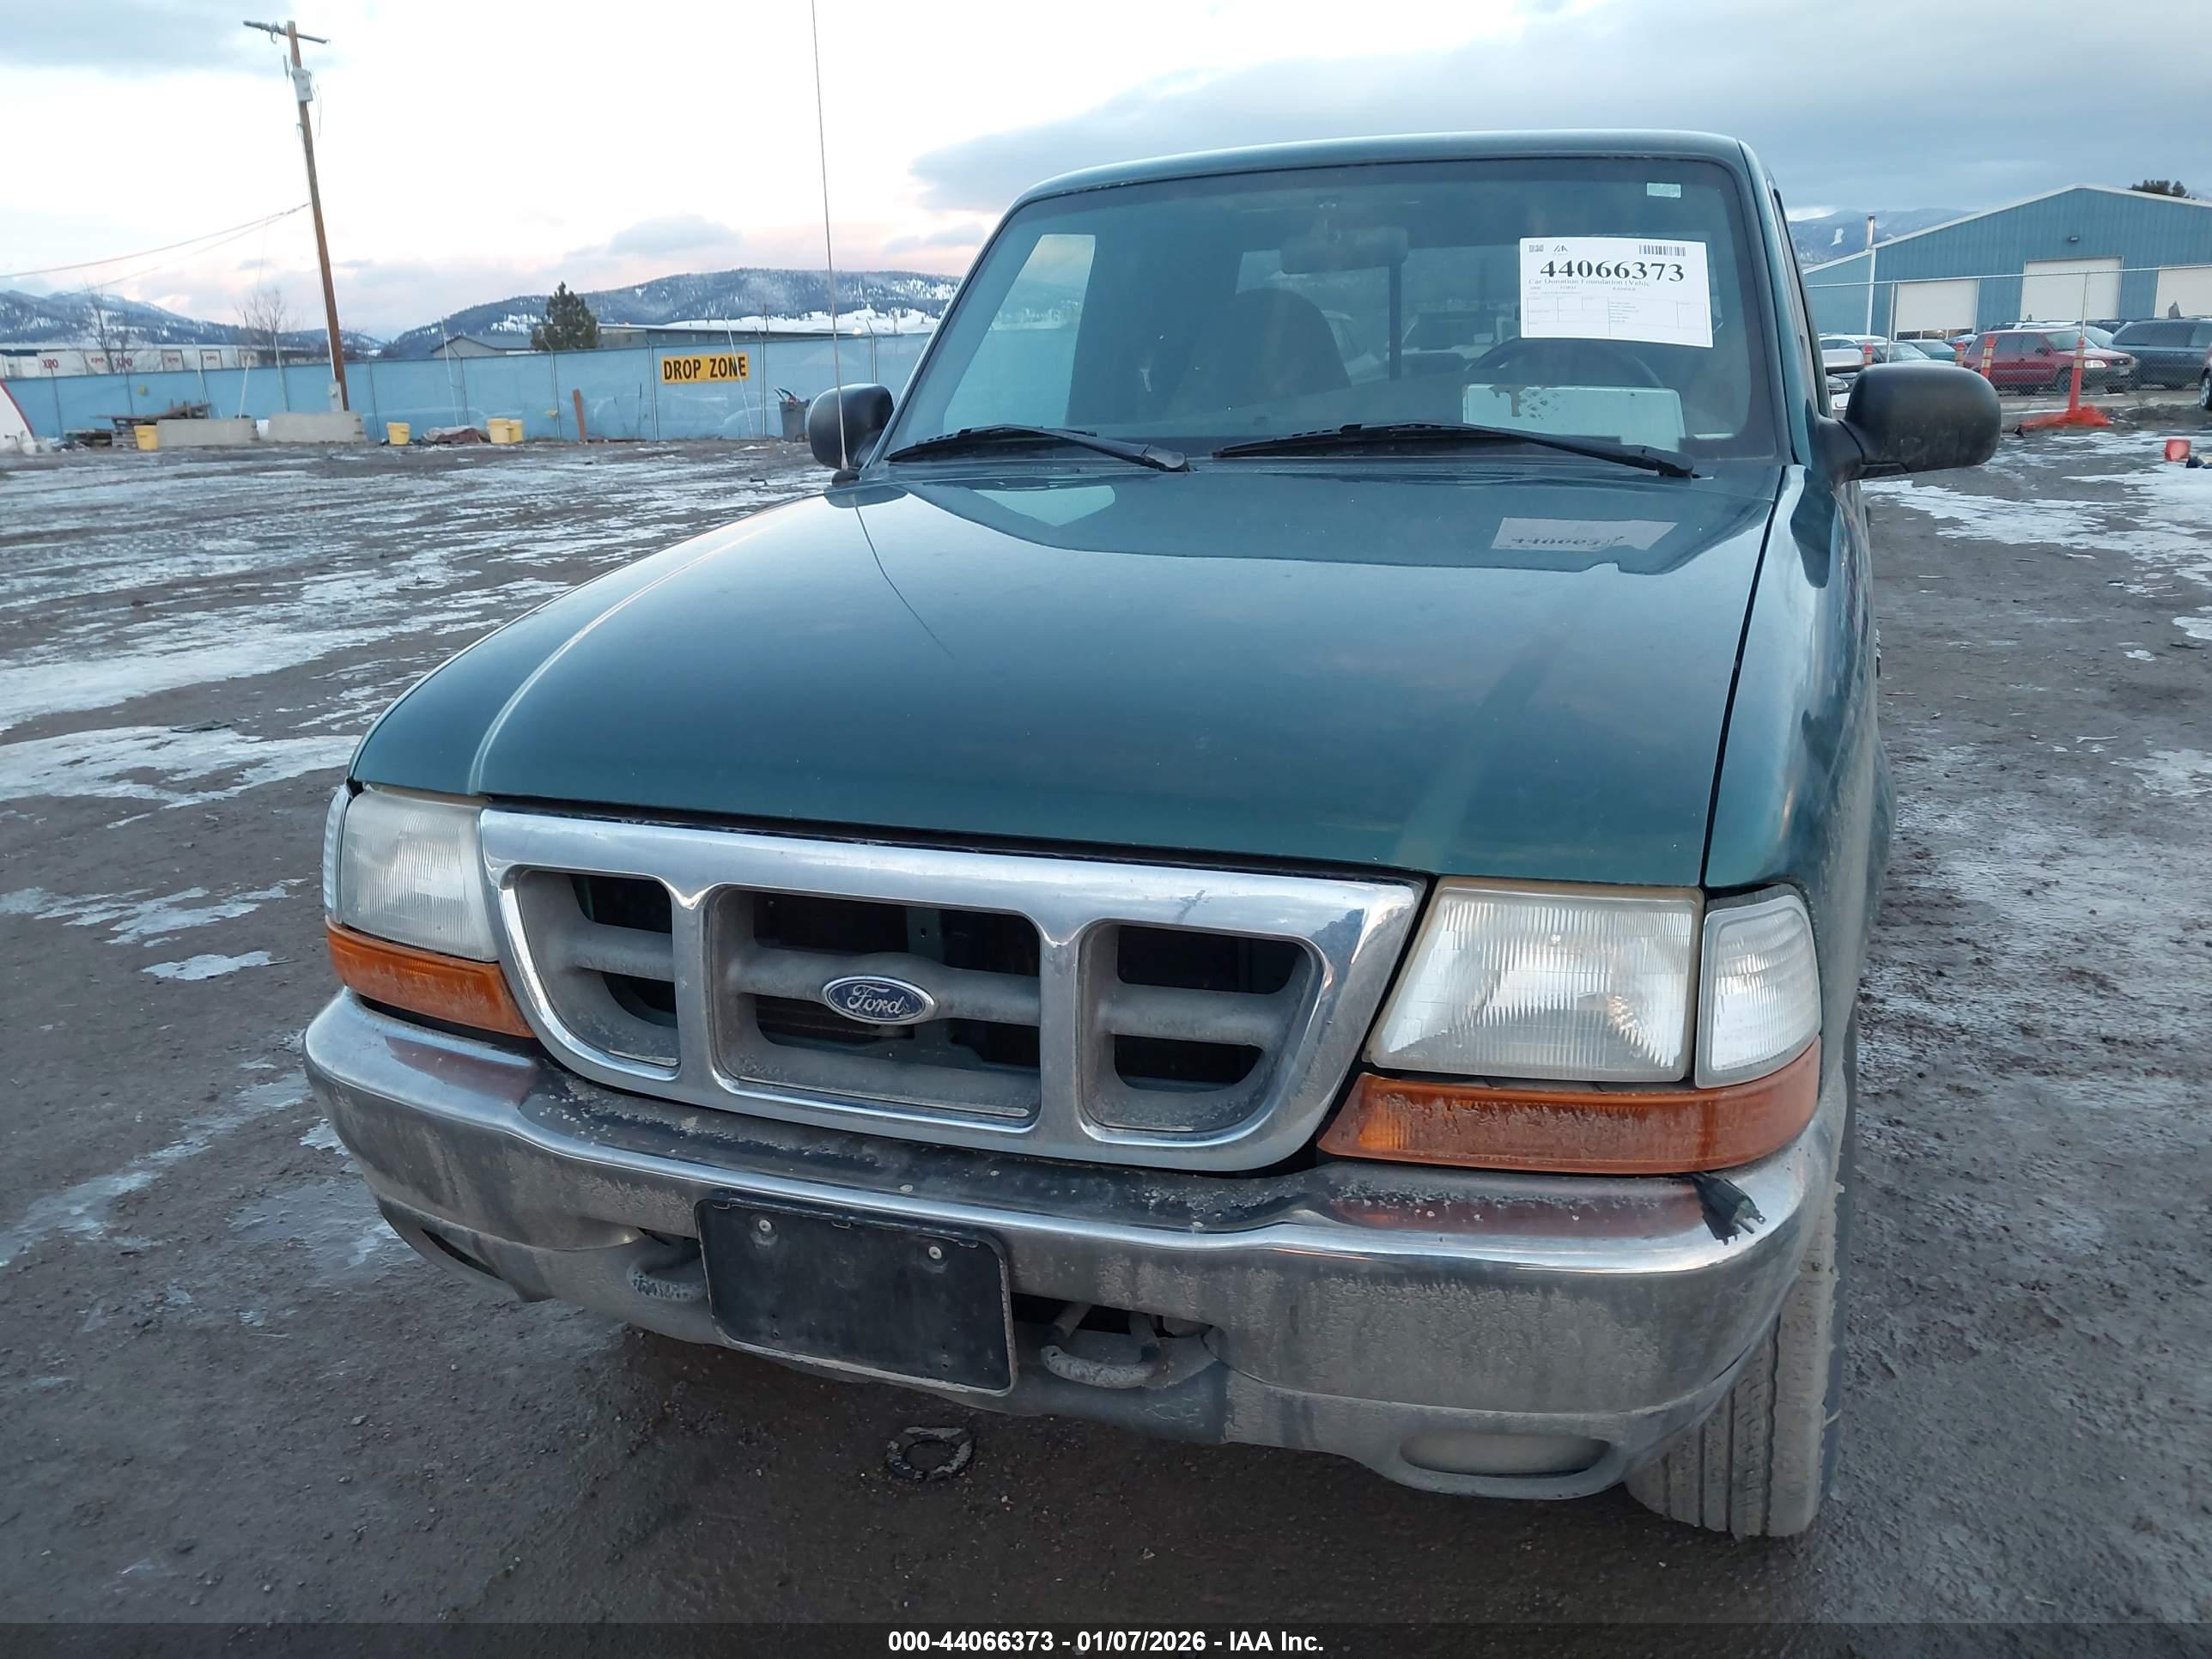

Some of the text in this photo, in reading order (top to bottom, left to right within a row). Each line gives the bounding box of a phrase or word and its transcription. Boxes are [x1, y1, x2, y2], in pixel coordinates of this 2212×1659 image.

[1540, 259, 1685, 282] 44066373
[42, 359, 59, 368] XPO
[663, 356, 747, 380] DROP ZONE
[846, 984, 904, 1014] Ford
